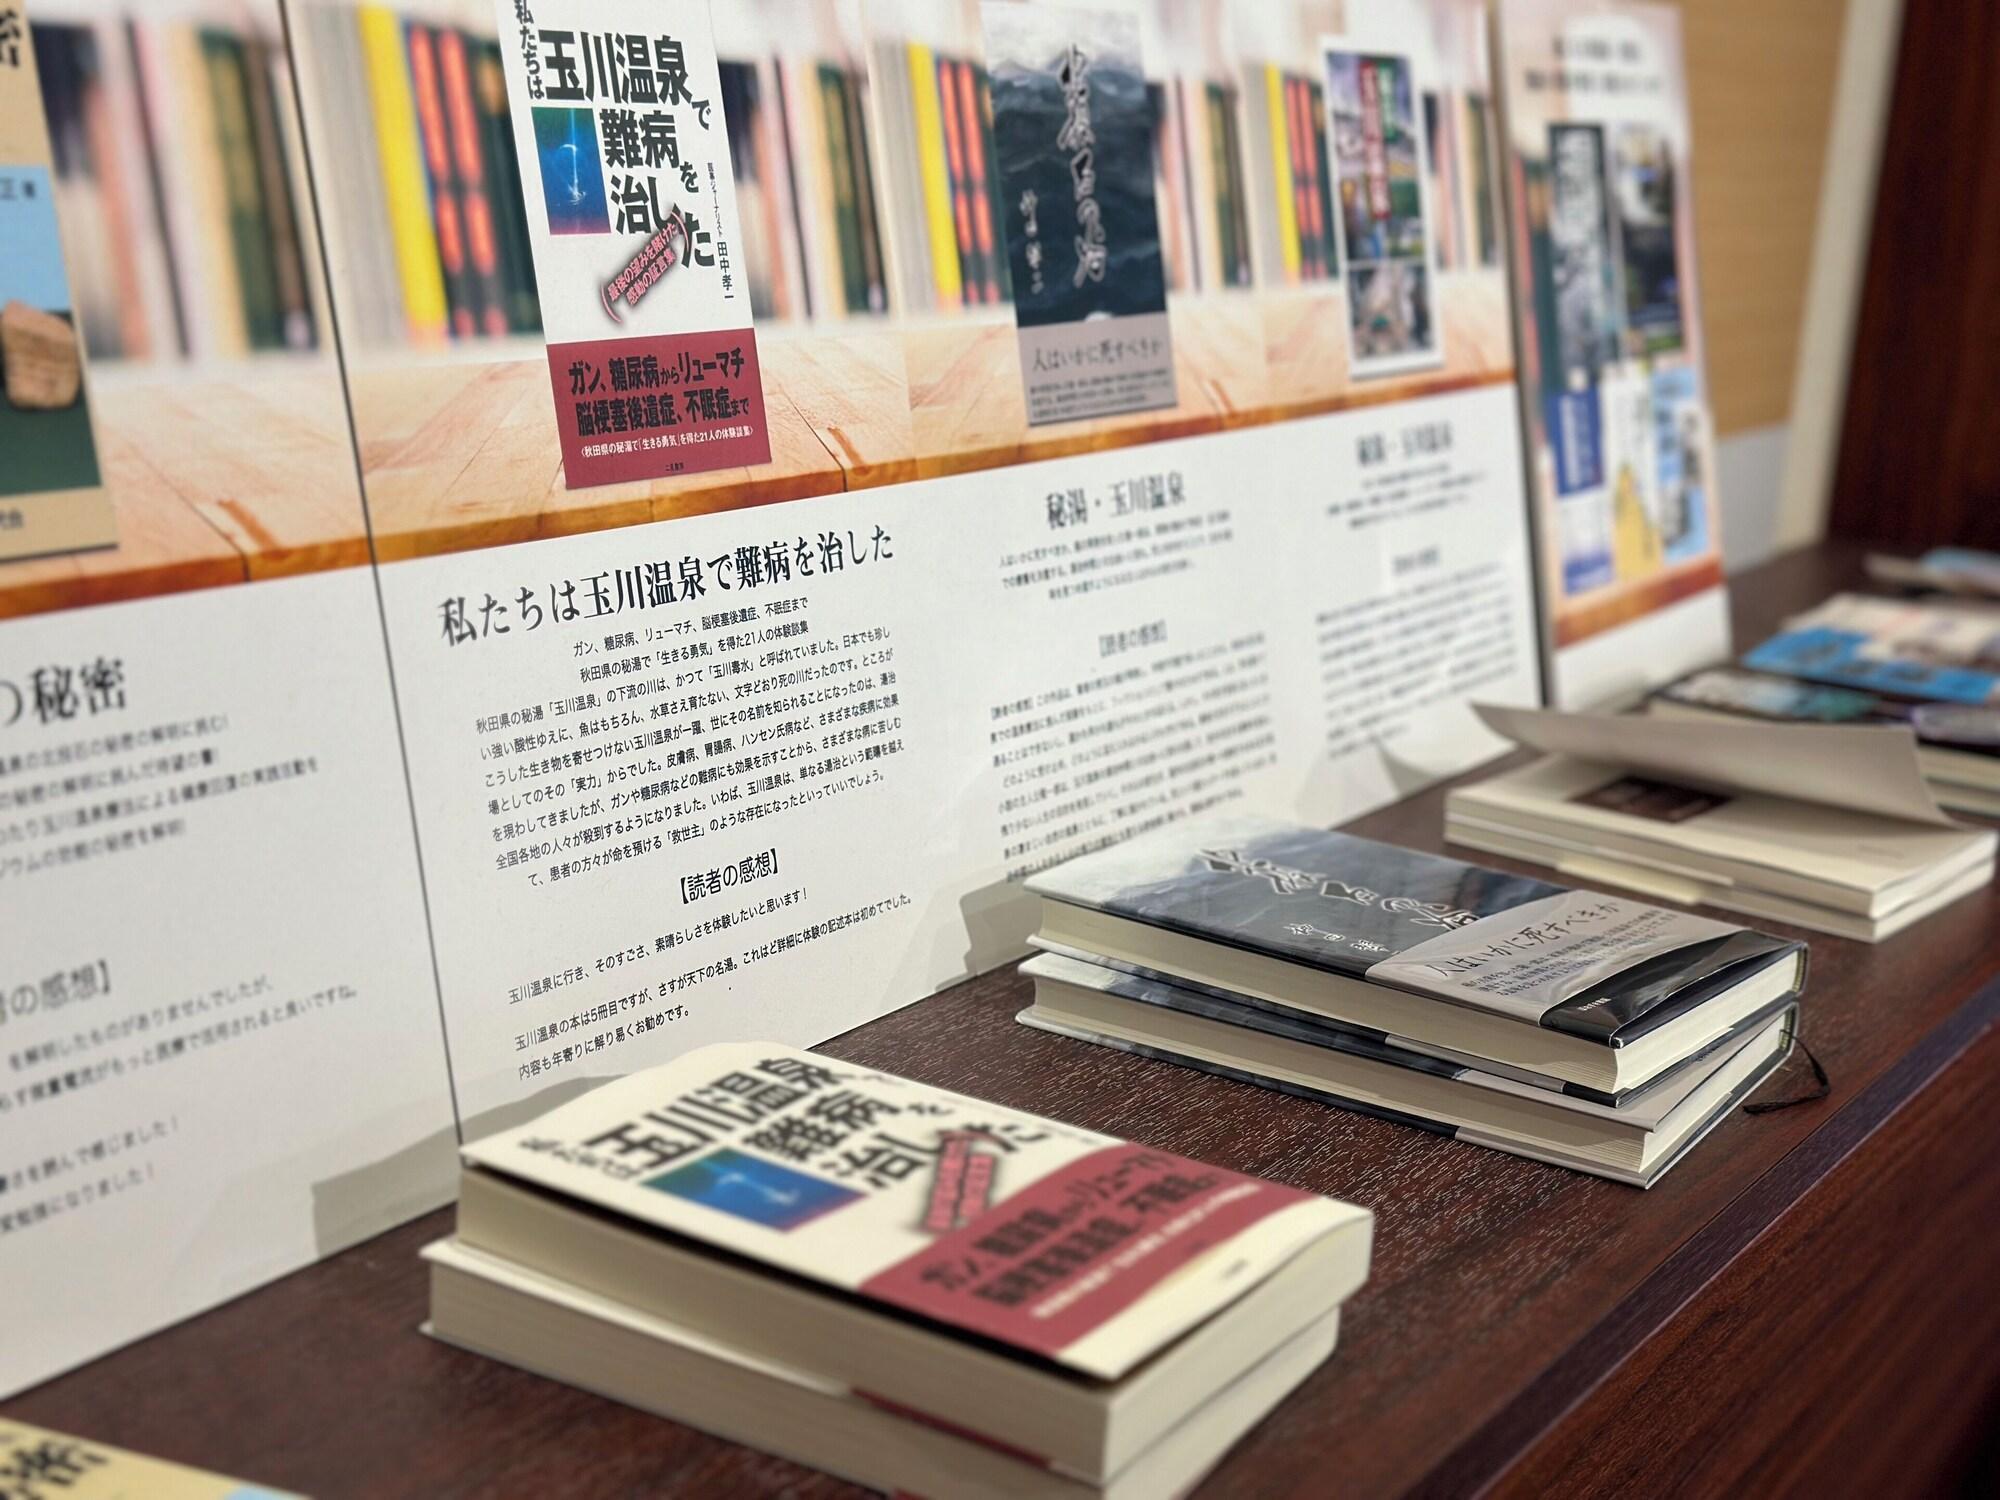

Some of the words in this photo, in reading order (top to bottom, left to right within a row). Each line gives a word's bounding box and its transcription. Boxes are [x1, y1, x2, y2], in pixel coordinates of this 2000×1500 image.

[599, 107, 700, 194] 難病を
[717, 241, 735, 299] 田中孝一
[569, 346, 745, 396] ガン、糖尿病からリューマチ
[575, 385, 749, 437] 脳梗塞後遺症、不眠症まで
[1046, 471, 1187, 530] 秘湯・玉川温泉
[440, 524, 894, 647] 私たちは玉川温泉で難病を治した
[680, 847, 779, 905] 【読者の感想】
[519, 1003, 689, 1081] 内容も年寄りに解り易くお勧めです。
